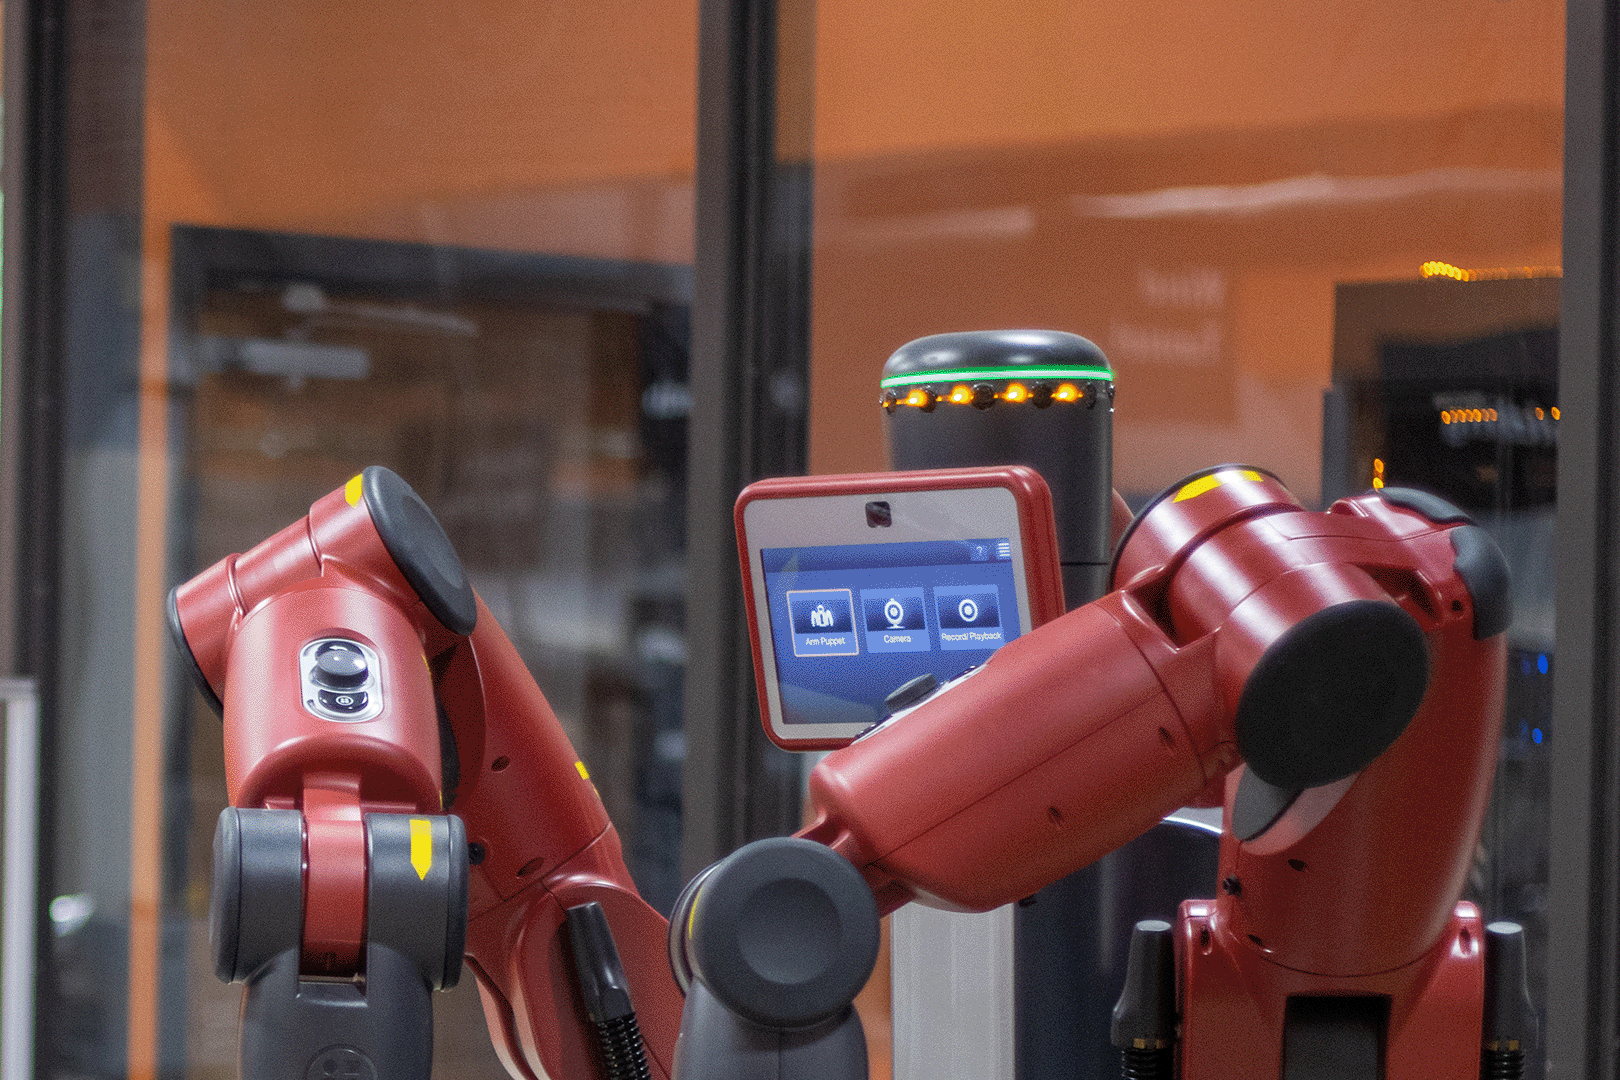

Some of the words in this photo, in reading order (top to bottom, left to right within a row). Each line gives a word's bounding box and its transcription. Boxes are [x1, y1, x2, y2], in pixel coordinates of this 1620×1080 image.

[805, 637, 820, 646] Arm
[820, 636, 847, 648] Puppet
[883, 634, 912, 644] Camera
